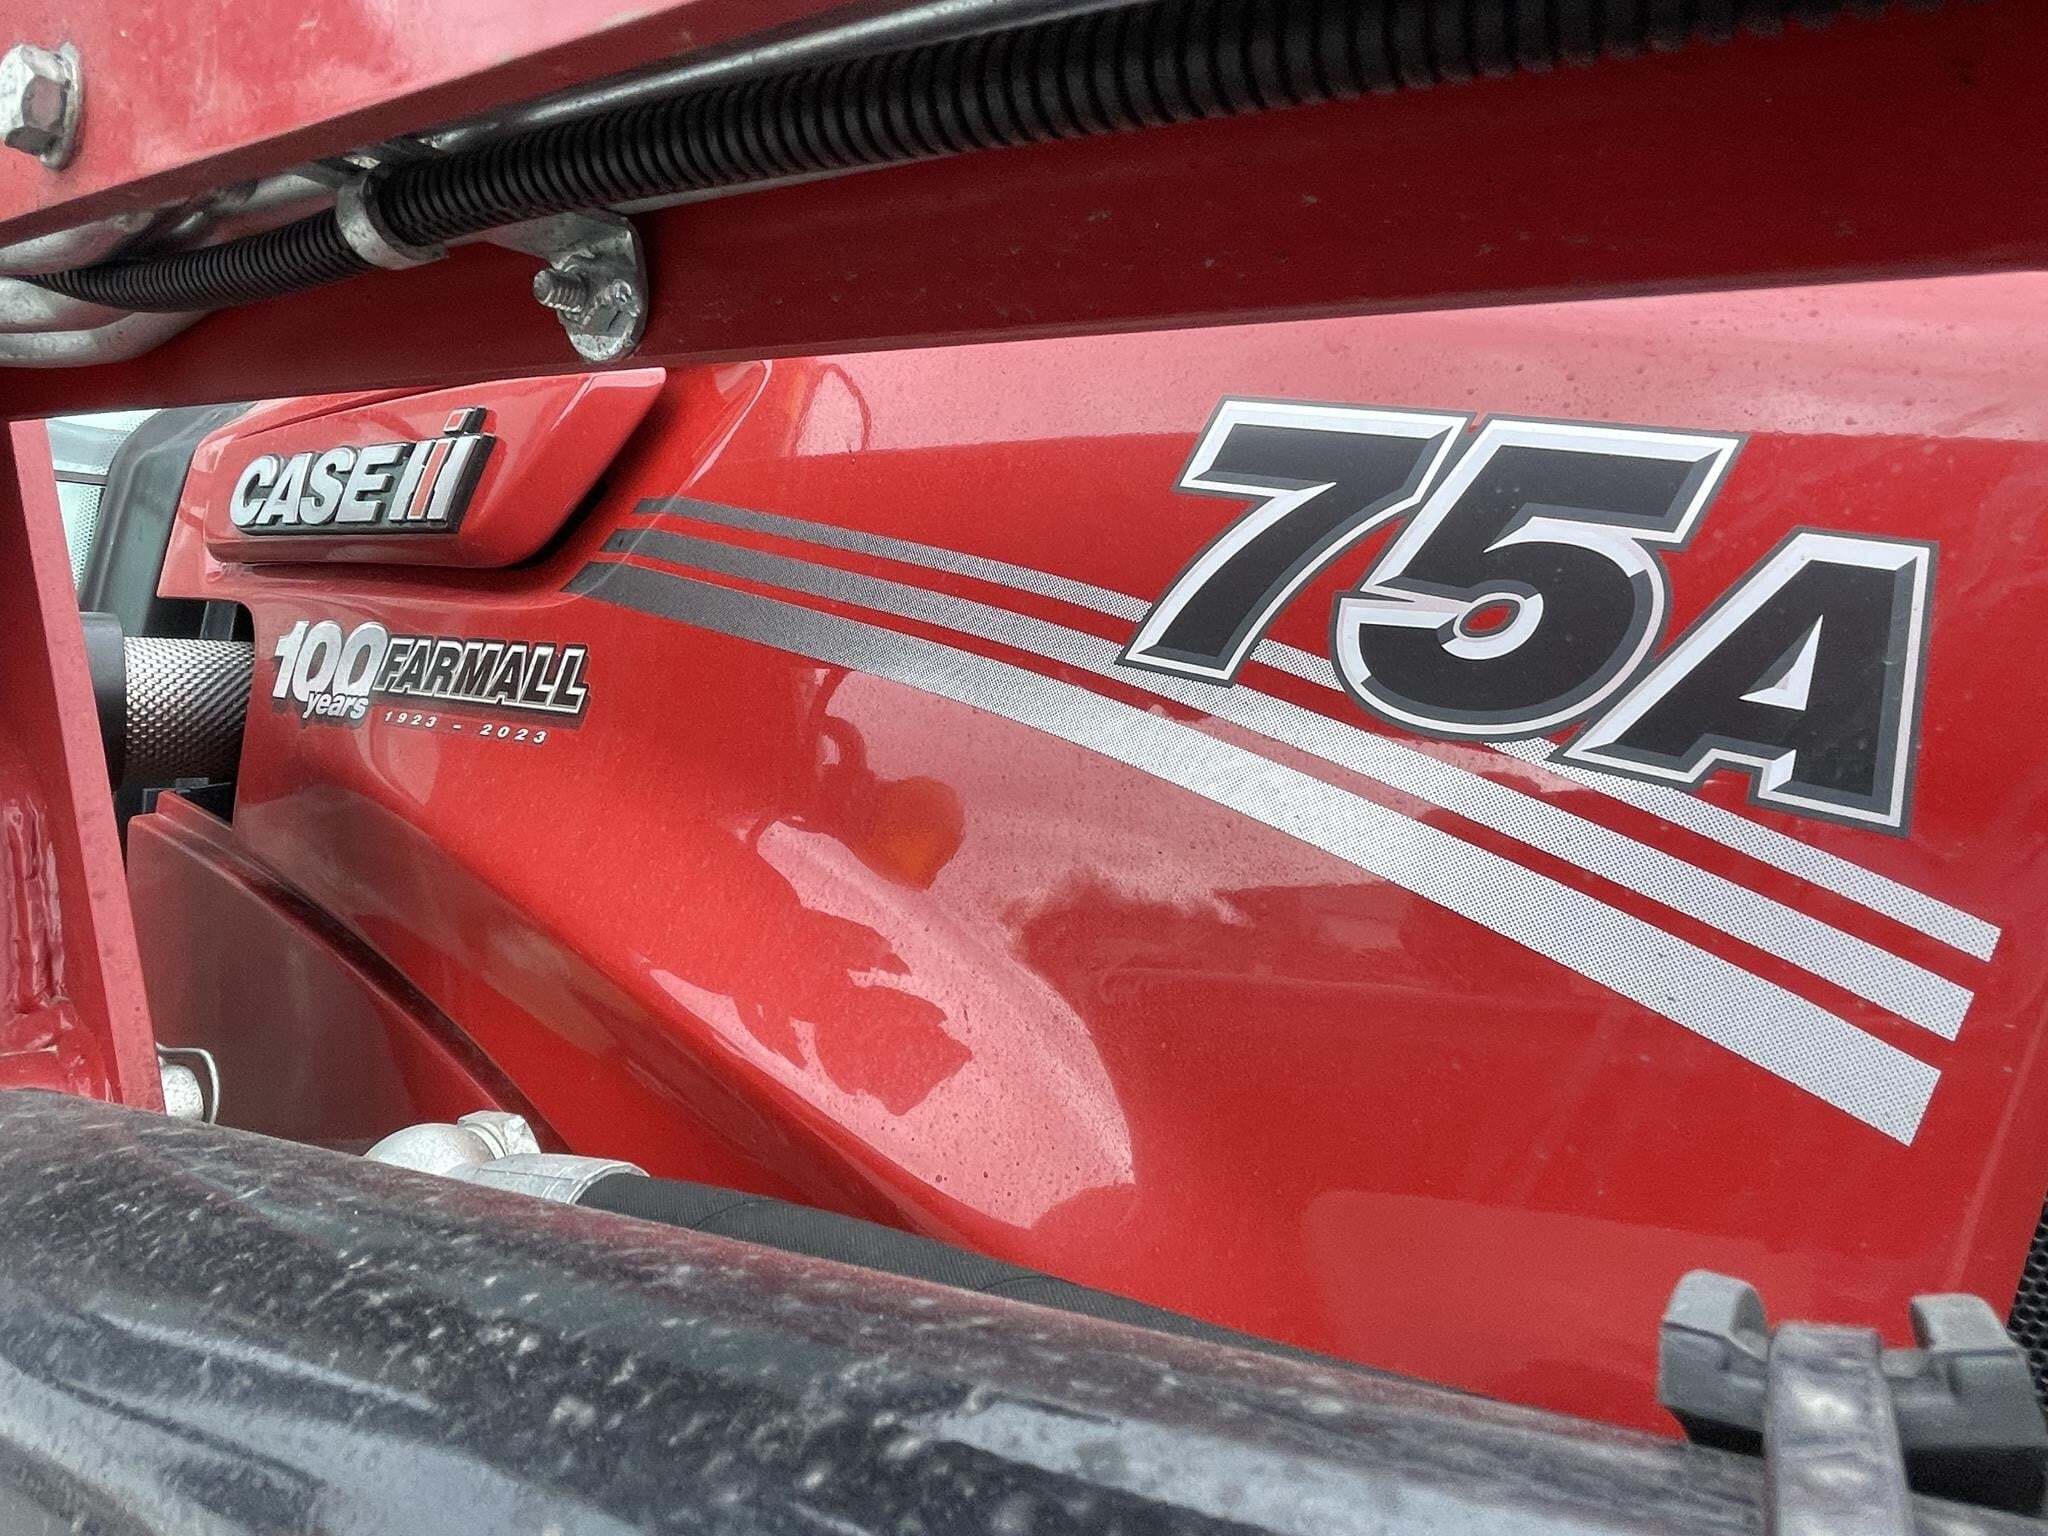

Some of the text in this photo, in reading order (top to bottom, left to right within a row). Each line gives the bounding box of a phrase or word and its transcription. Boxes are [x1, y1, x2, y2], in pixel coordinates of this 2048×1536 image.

[229, 445, 404, 530] CASE
[1116, 396, 1939, 837] 75A
[272, 621, 589, 714] 100 FARMALL
[303, 692, 369, 720] years
[384, 711, 438, 728] 1923
[479, 723, 549, 744] 2023
